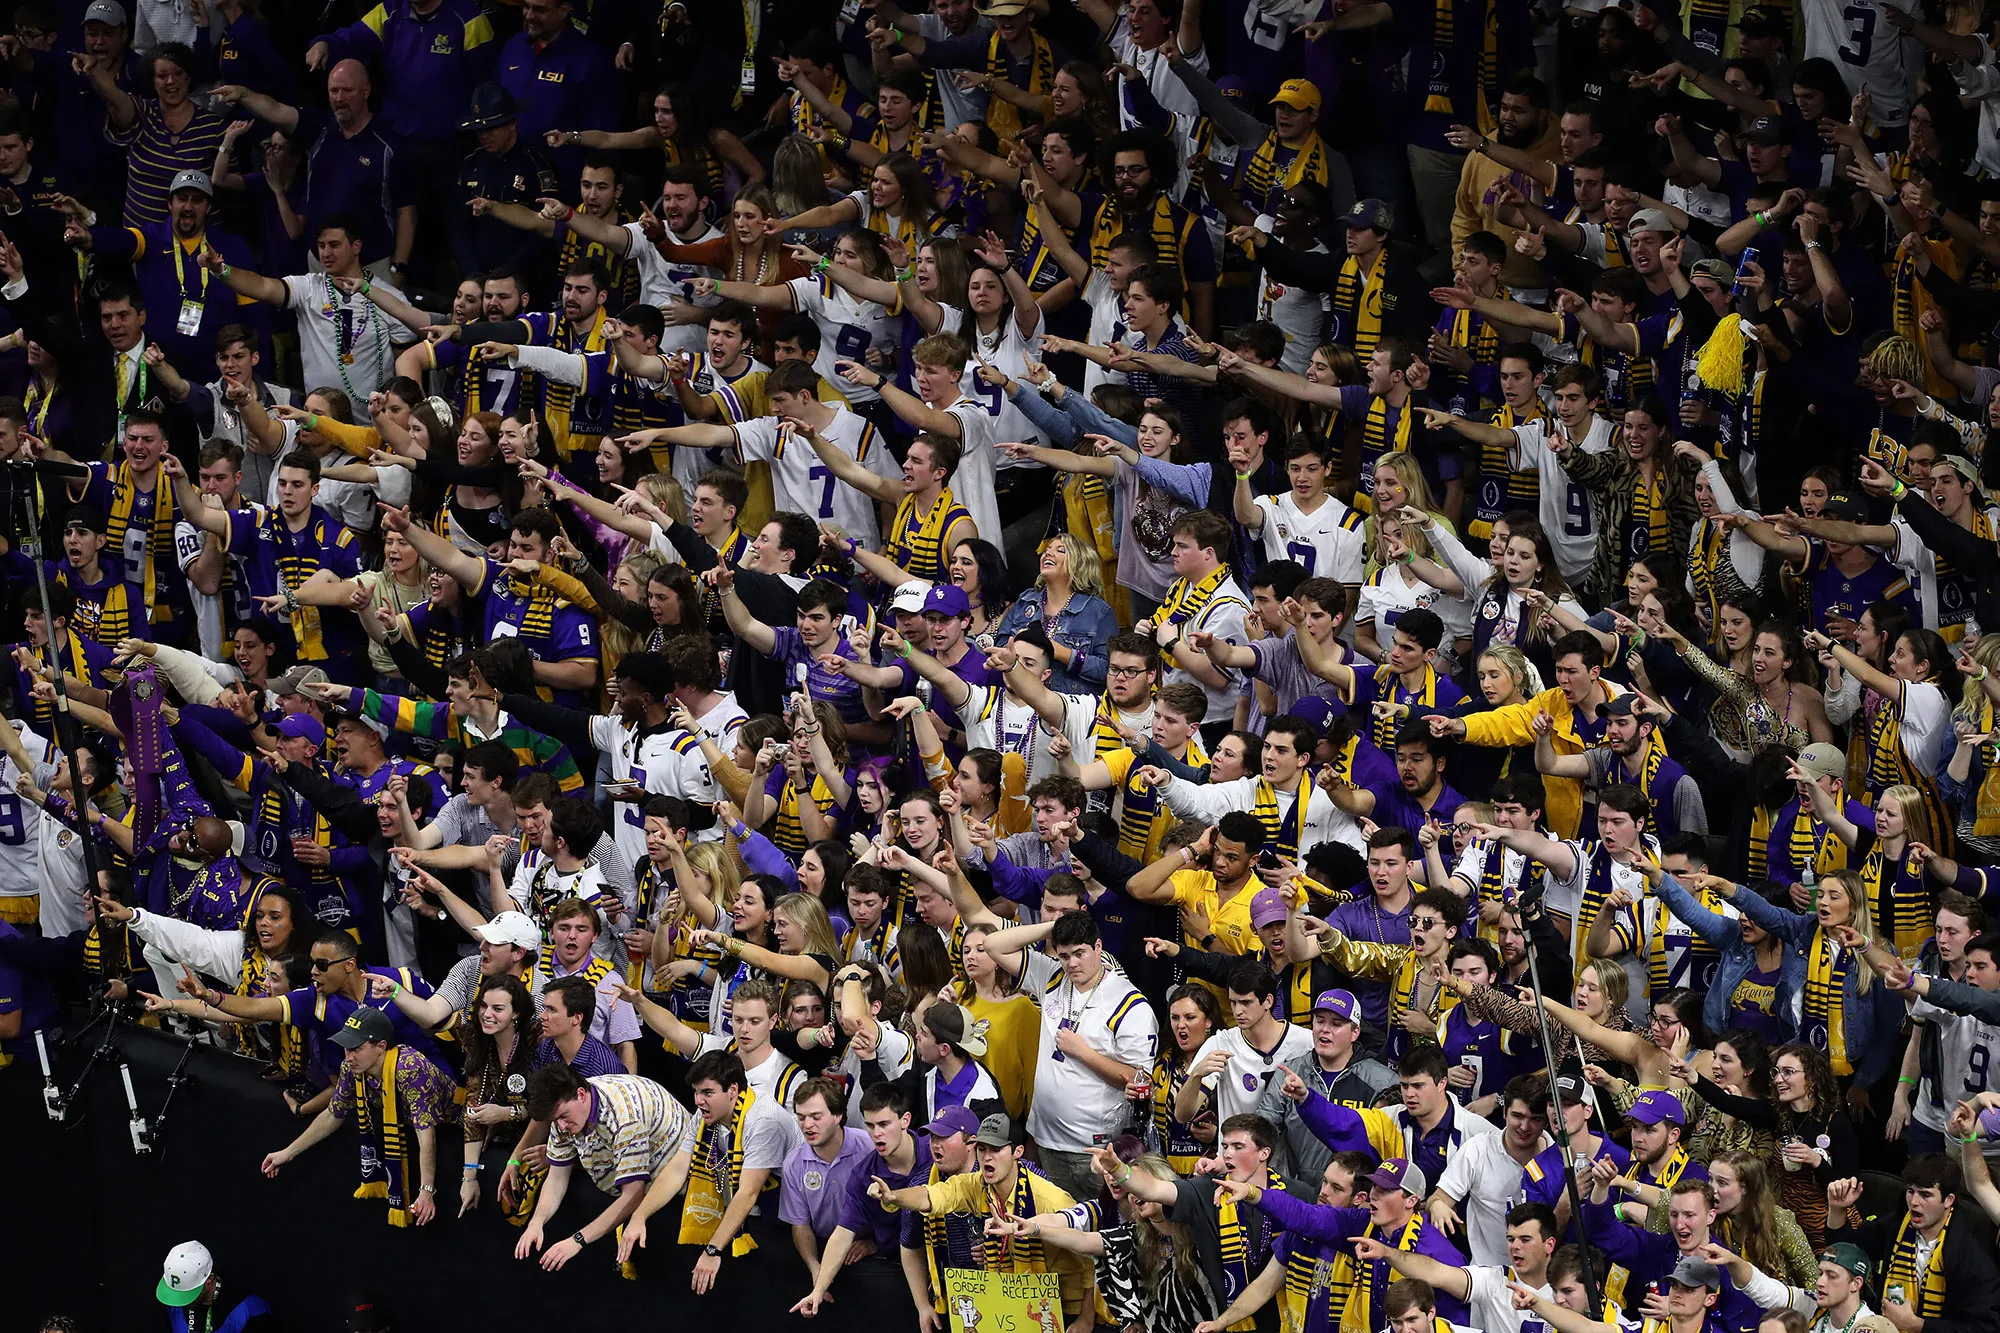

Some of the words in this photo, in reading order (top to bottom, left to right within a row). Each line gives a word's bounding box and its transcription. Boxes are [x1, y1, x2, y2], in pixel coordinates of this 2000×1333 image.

[1839, 6, 1877, 68] 3
[223, 50, 239, 60] SU
[538, 70, 565, 83] LSU
[1221, 88, 1245, 97] LSU
[1283, 84, 1300, 92] LSU
[1429, 84, 1450, 93] YOFF
[1698, 206, 1712, 216] LSU
[1382, 292, 1398, 301] LSU
[486, 367, 516, 416] 7
[574, 424, 603, 433] PLAYO
[809, 465, 837, 519] 7
[1831, 494, 1849, 503] LSU
[1564, 483, 1592, 537] 9
[1295, 535, 1311, 543] LSU
[124, 528, 147, 584] 9
[578, 623, 591, 646] 9
[1800, 753, 1817, 762] LSU
[699, 764, 712, 787] 3
[0, 795, 26, 846] 9
[203, 889, 220, 902] LSU
[1104, 915, 1123, 923] LSU
[1665, 935, 1691, 989] 7
[1353, 1010, 1362, 1020] LS
[345, 1016, 362, 1030] SU
[1147, 1034, 1157, 1057] 7
[1963, 1044, 1991, 1093] 9
[1333, 1098, 1365, 1110] LSU
[1638, 1096, 1655, 1105] LSU
[171, 1274, 181, 1288] P
[945, 1268, 990, 1282] ONLINE
[1001, 1273, 1032, 1287] WHAT
[1034, 1274, 1059, 1287] YOU
[952, 1282, 986, 1295] ORDER
[1002, 1286, 1061, 1300] RECEIVED
[994, 1312, 1017, 1332] VS
